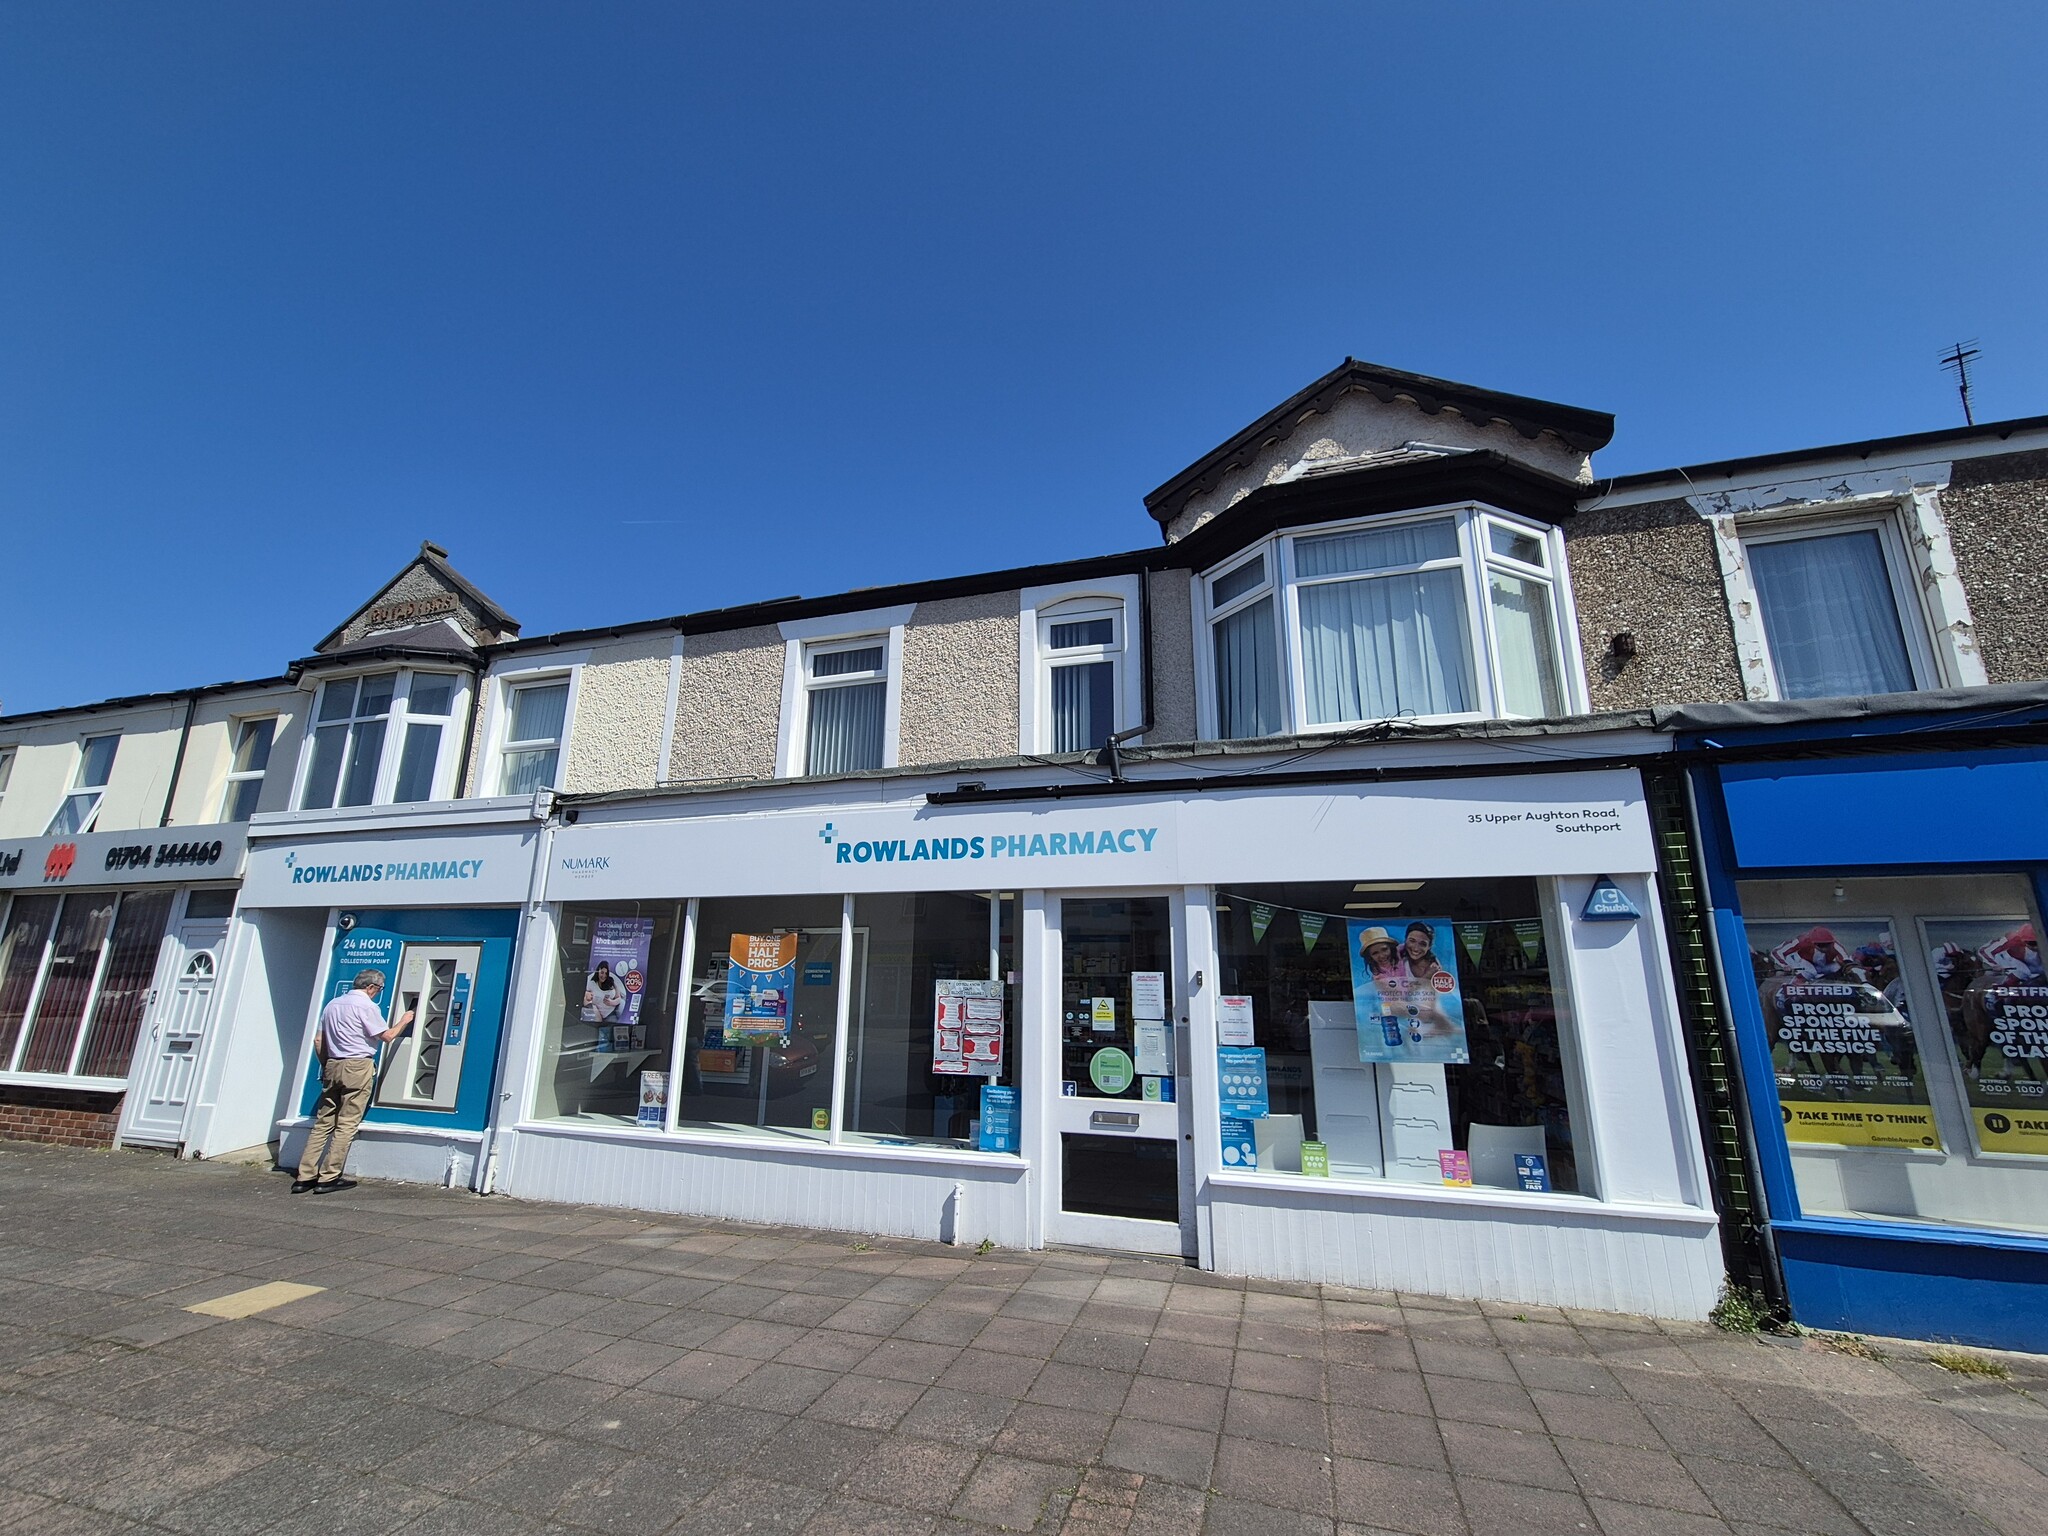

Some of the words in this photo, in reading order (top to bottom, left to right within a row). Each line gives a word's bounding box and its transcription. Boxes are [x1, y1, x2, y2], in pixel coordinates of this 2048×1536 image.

[1467, 814, 1482, 823] 35
[1485, 813, 1522, 824] Upper
[1525, 810, 1580, 822] Aughton
[1583, 808, 1620, 818] Road,
[1555, 822, 1622, 834] Southport
[836, 836, 985, 864] ROWLANDS
[990, 827, 1158, 858] PHARMACY
[105, 845, 152, 870] 01704
[154, 840, 222, 868] 544460
[561, 856, 611, 870] NUMARK
[292, 863, 383, 884] ROWLANDS
[384, 859, 484, 881] PHARMACY
[1602, 889, 1615, 902] C
[1594, 903, 1629, 912] Chubb
[623, 921, 632, 929] for
[343, 939, 356, 949] 24
[359, 939, 392, 949] HOUR
[596, 937, 610, 945] that
[748, 947, 780, 958] HALF
[747, 958, 779, 968] PRICE
[626, 978, 642, 986] 20%
[1786, 986, 1853, 996] BETFRED
[1791, 1003, 1856, 1015] PROUD
[2003, 1005, 2048, 1018] PRO
[1783, 1015, 1871, 1028] SPONSOR
[1778, 1028, 1802, 1040] OF
[1804, 1028, 1840, 1040] THE
[1842, 1029, 1881, 1041] FIVE
[1989, 1031, 2016, 1044] OF
[1788, 1041, 1877, 1054] CLASSICS
[1774, 1078, 1794, 1086] 000
[1798, 1079, 1823, 1087] 1000
[1979, 1084, 2011, 1092] 2000
[2016, 1086, 2043, 1094] 1000
[1796, 1111, 1828, 1120] TAKE
[1831, 1112, 1863, 1122] TIME
[1866, 1114, 1884, 1122] TO
[1886, 1114, 1928, 1124] THINK
[1871, 1135, 1920, 1144] GambleAware
